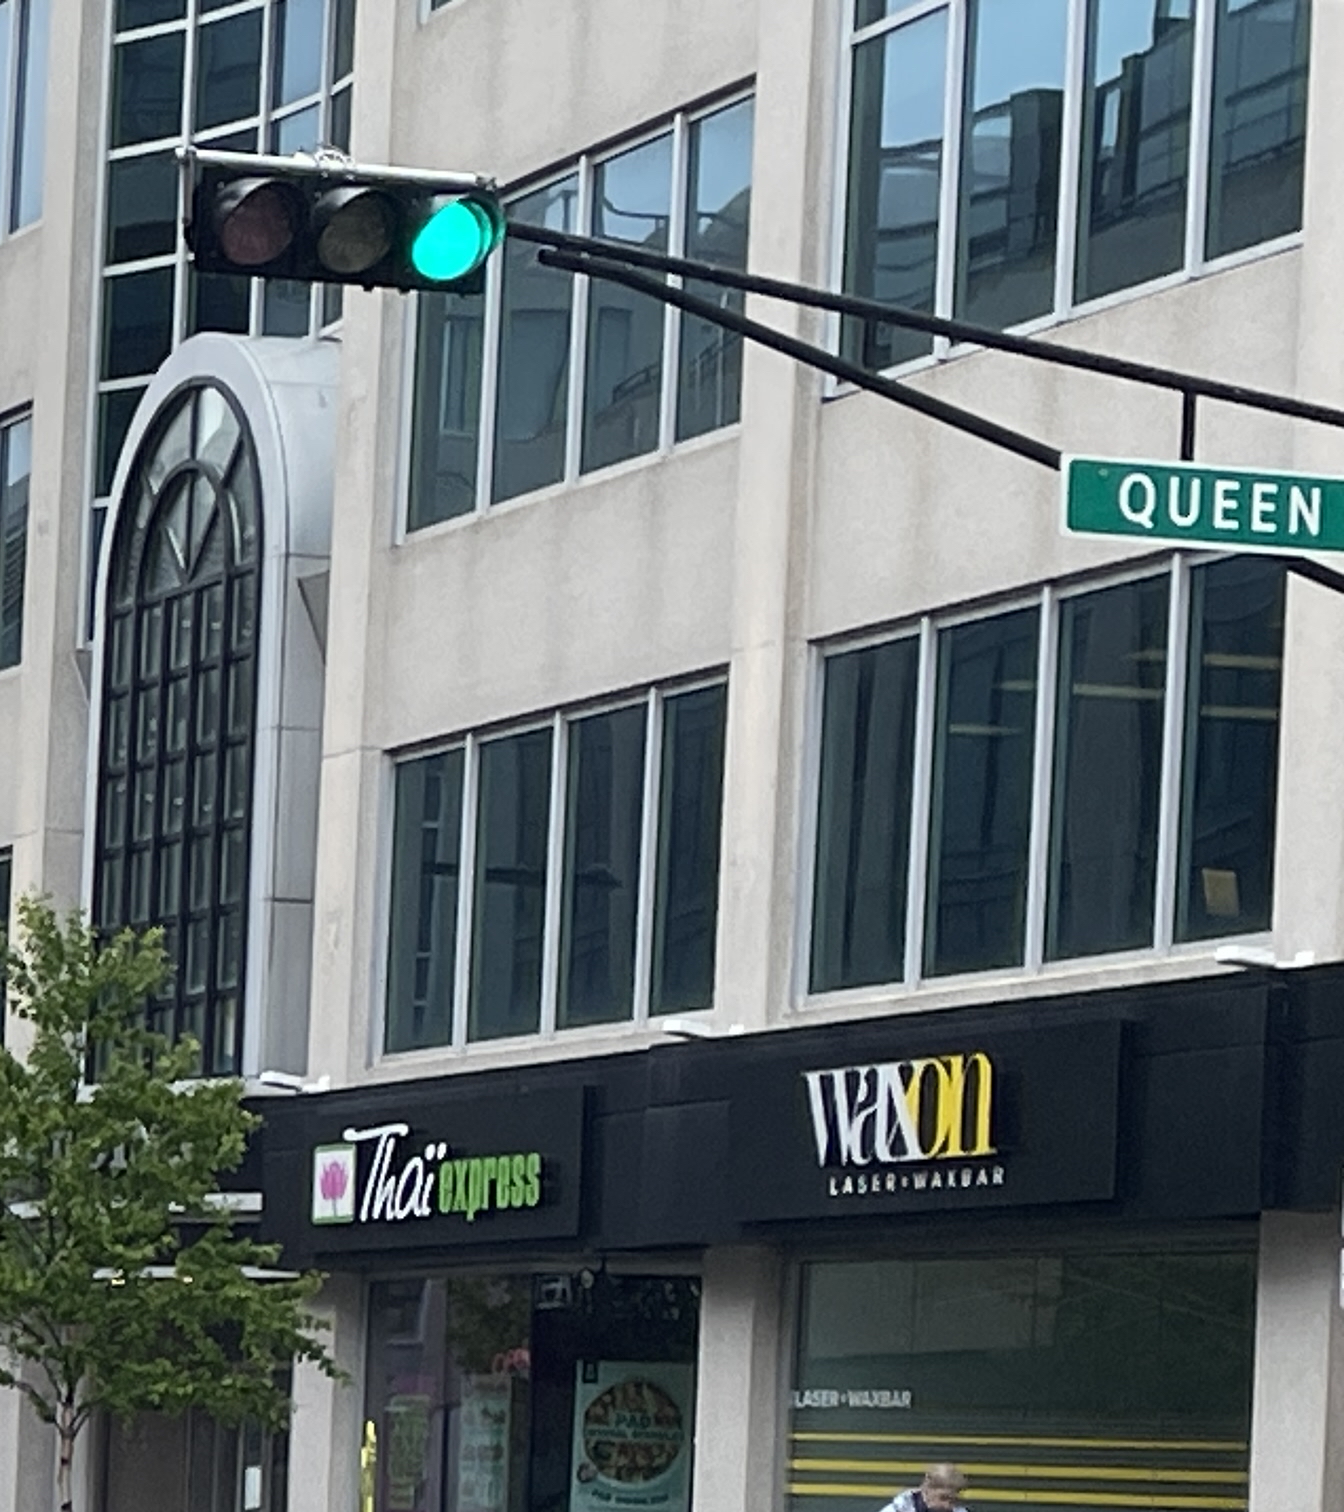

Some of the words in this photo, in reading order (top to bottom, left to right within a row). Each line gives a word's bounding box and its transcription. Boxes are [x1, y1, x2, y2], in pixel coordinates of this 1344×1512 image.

[1119, 473, 1321, 537] QUEEN
[439, 1152, 541, 1221] express
[829, 1172, 897, 1196] LASER
[913, 1166, 1004, 1190] WAXBAR
[795, 1389, 839, 1408] LASER
